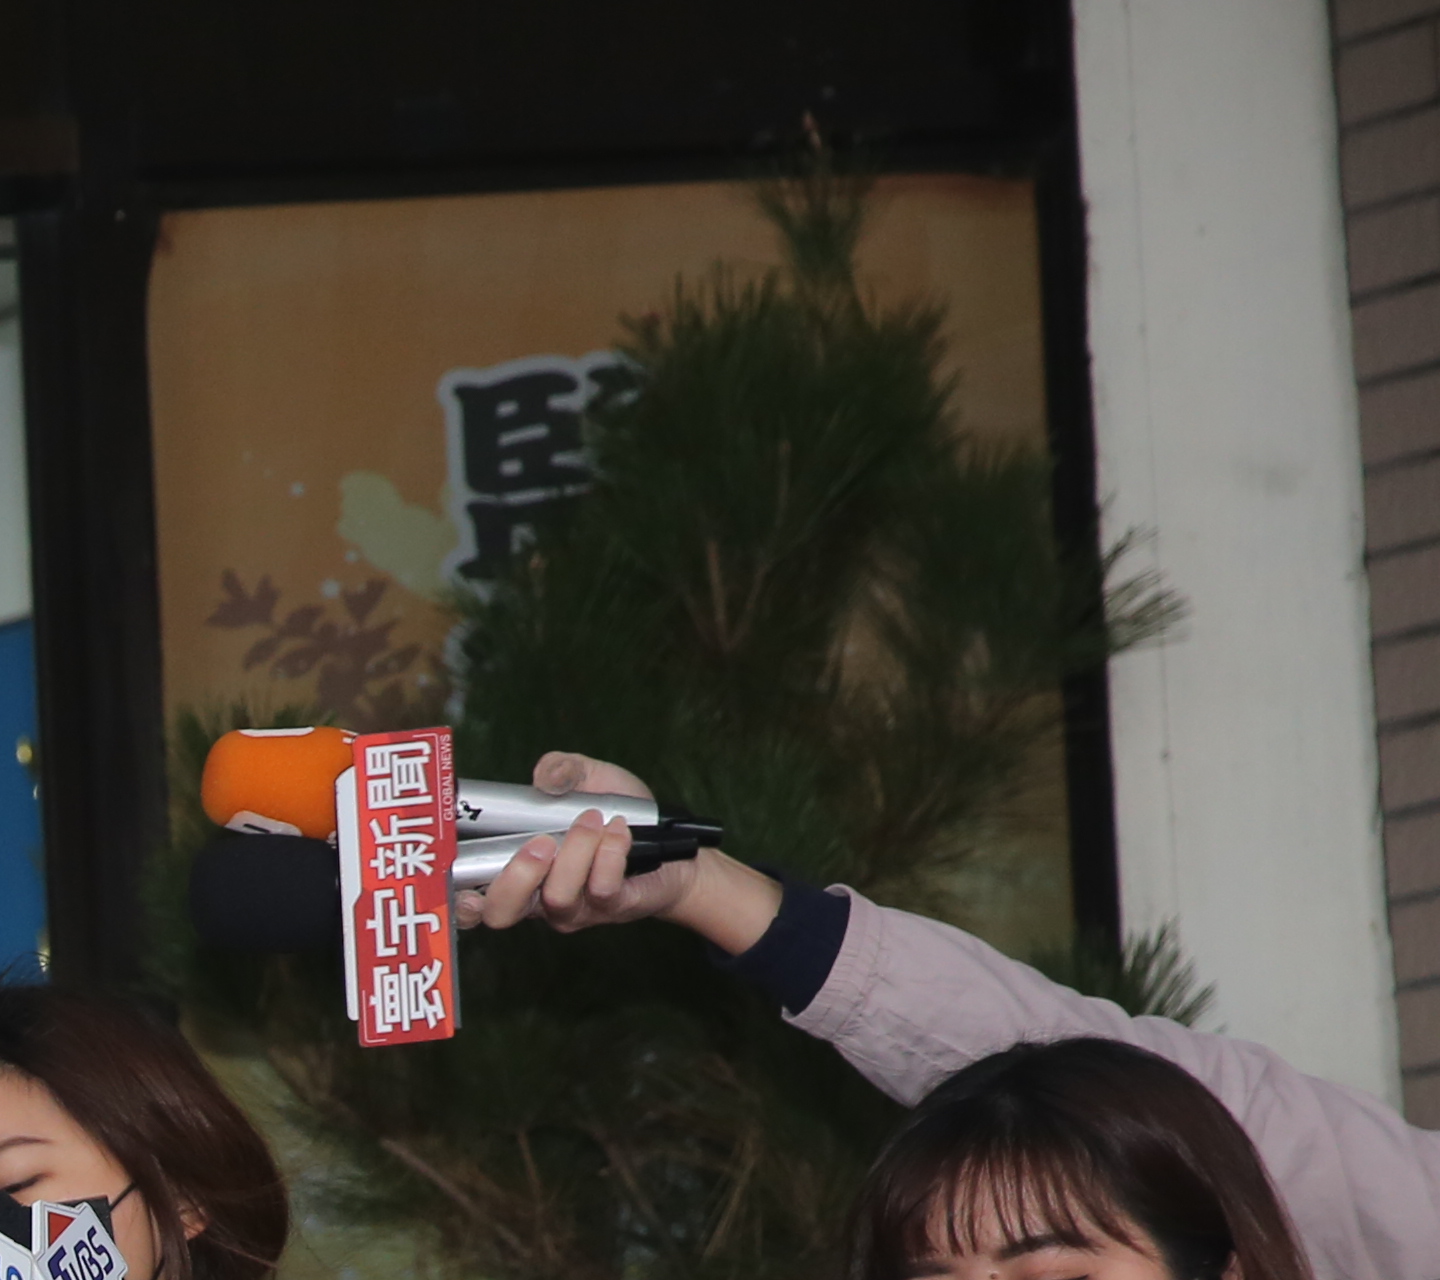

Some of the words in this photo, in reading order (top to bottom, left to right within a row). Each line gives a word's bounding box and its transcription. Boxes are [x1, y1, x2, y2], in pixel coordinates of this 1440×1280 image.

[440, 733, 452, 771] NEWS
[441, 772, 454, 821] GLOBAL
[365, 740, 446, 1034] 寰宇新聞
